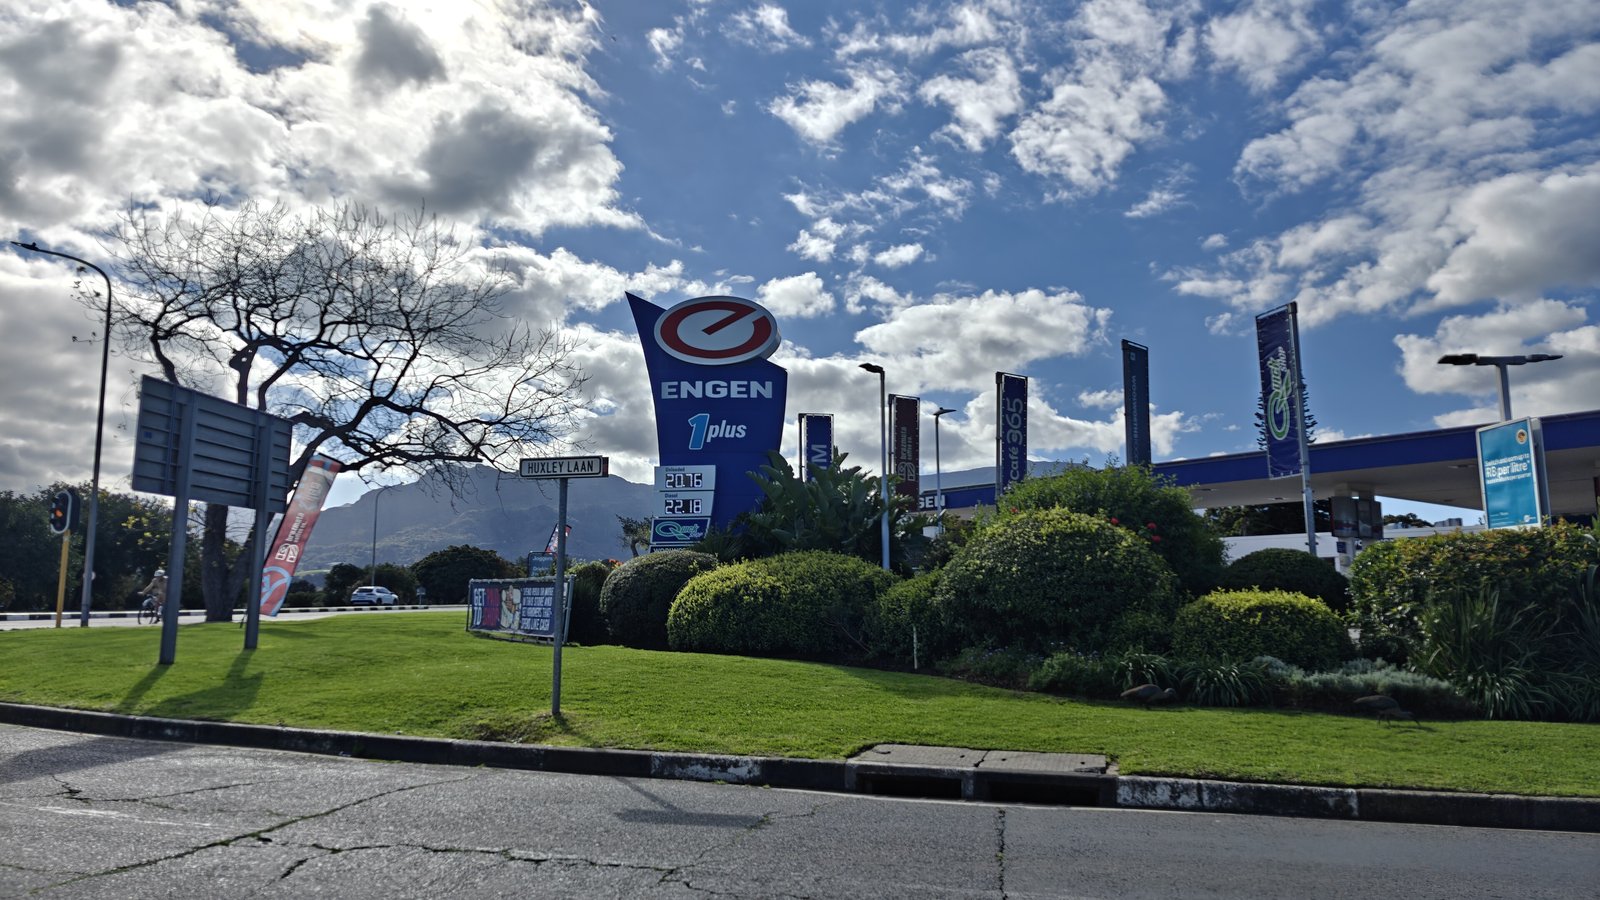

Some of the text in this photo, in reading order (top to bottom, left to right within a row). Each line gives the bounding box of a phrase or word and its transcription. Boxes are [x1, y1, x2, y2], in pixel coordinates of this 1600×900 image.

[661, 380, 773, 399] ENGEN
[1005, 397, 1024, 480] café 365
[527, 460, 594, 474] HUXLEY LAAN
[1497, 466, 1509, 479] per
[665, 473, 702, 488] 20.76
[665, 499, 702, 514] 22.18
[473, 588, 485, 607] GET
